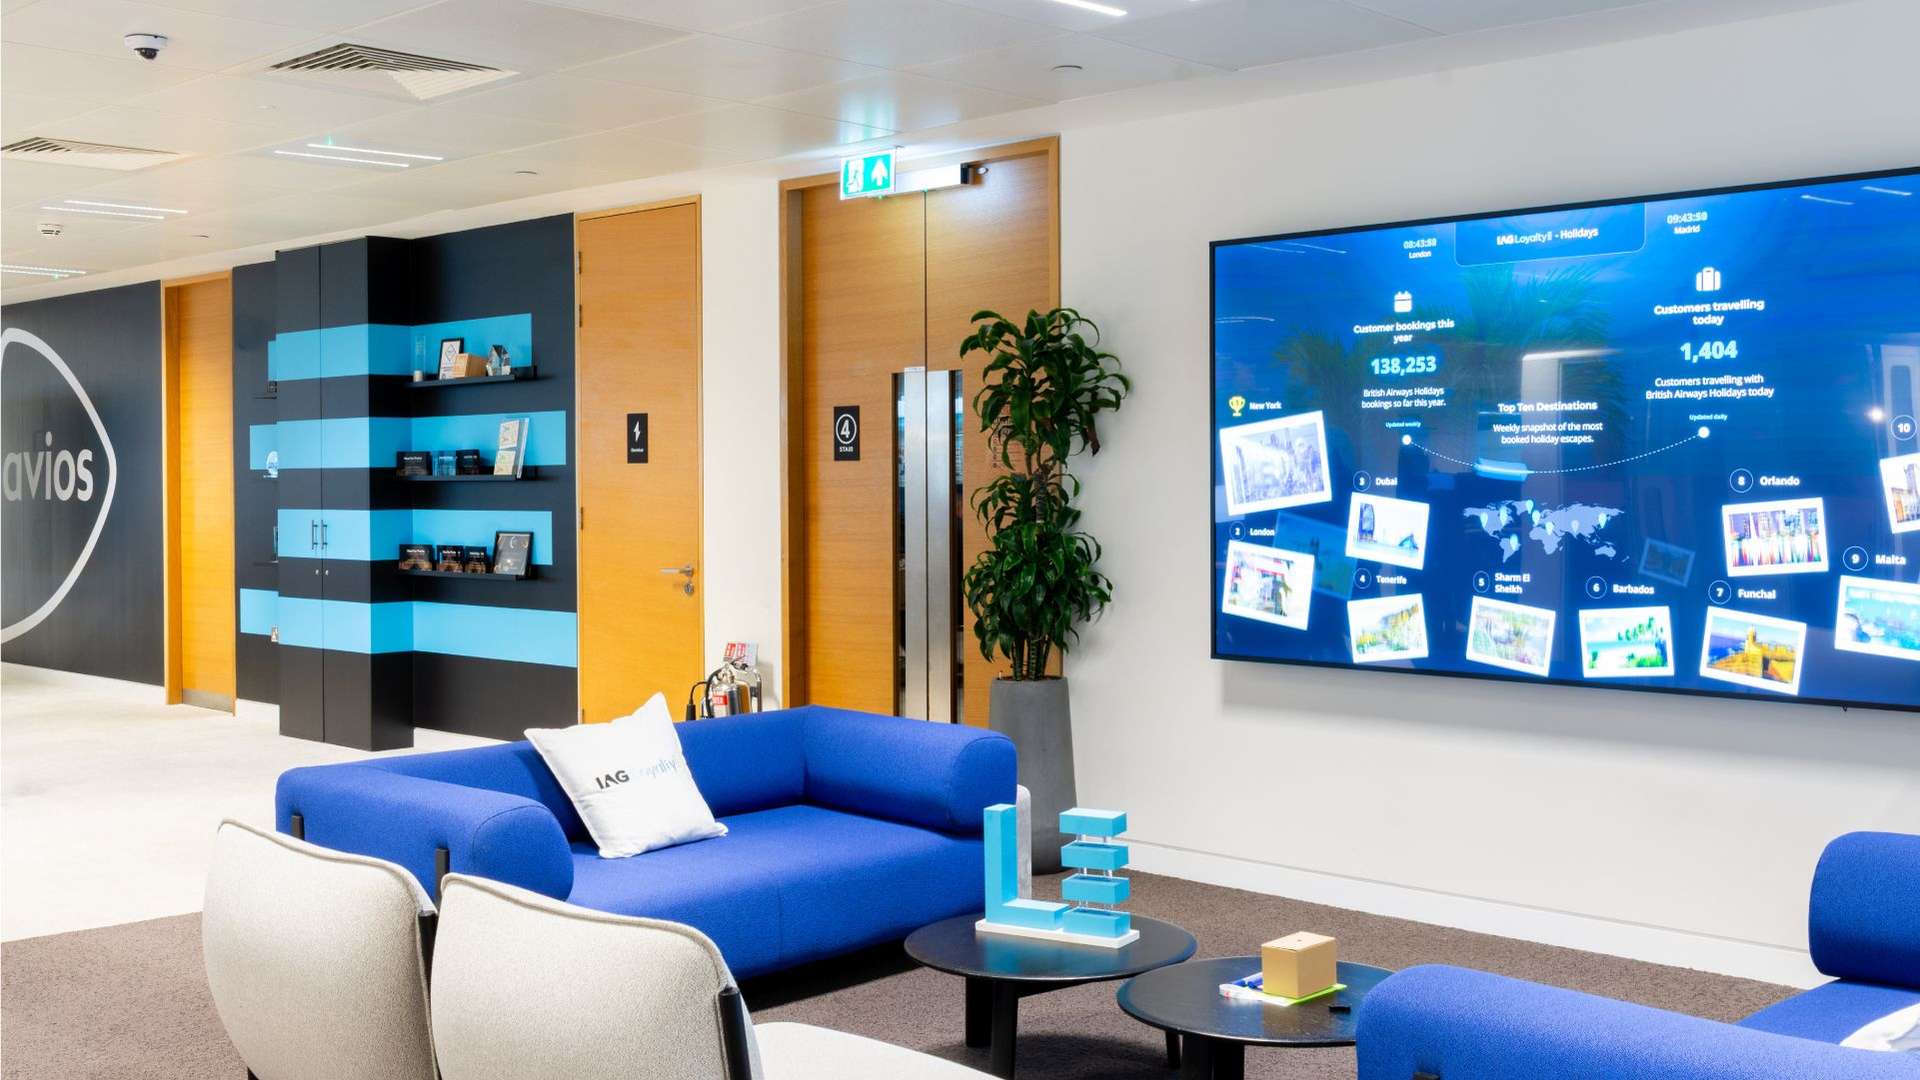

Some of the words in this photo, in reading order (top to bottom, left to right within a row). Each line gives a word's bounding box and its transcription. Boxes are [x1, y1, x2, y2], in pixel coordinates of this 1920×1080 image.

[1674, 225, 1701, 234] Madrid
[1497, 235, 1515, 245] IAG
[1560, 228, 1599, 239] Holidays
[1408, 251, 1432, 259] London
[1654, 303, 1711, 315] Customers
[1712, 299, 1765, 311] travelling
[1353, 324, 1395, 334] Customer
[1396, 321, 1437, 332] bookings
[1437, 318, 1455, 329] this
[1692, 314, 1724, 326] today
[1393, 334, 1413, 344] year
[1680, 340, 1738, 363] 1,404
[1371, 355, 1437, 376] 138,253
[1655, 377, 1700, 387] Customers
[1702, 374, 1743, 386] travelling
[1743, 373, 1764, 384] with
[1363, 389, 1385, 398] British
[1386, 388, 1413, 398] Airways
[1414, 386, 1445, 397] Holidays
[1645, 390, 1673, 400] British
[1674, 389, 1708, 400] Airways
[1709, 387, 1746, 399] Holidays
[1748, 386, 1774, 398] today
[1249, 402, 1265, 411] New
[1265, 400, 1282, 409] York
[1361, 400, 1392, 410] bookings
[1402, 399, 1413, 408] far
[1414, 398, 1427, 407] this
[1428, 400, 1447, 409] year.
[1497, 402, 1517, 414] Top
[1517, 401, 1535, 412] Ten
[1536, 399, 1598, 411] Destinations
[840, 419, 850, 439] 4
[1492, 424, 1520, 434] Weekly
[1521, 422, 1557, 434] snapshot
[1557, 421, 1567, 431] of
[1567, 421, 1581, 431] the
[1582, 422, 1603, 431] most
[1898, 423, 1911, 433] 10
[1501, 435, 1530, 444] booked
[1530, 434, 1559, 445] holiday
[1560, 435, 1594, 445] escapes.
[2, 431, 94, 501] avios
[1359, 477, 1365, 486] 3
[1375, 477, 1398, 486] Dubai
[1738, 476, 1745, 486] 8
[1759, 476, 1801, 486] Orlando
[1235, 527, 1240, 535] 2
[1249, 528, 1276, 536] London
[1851, 554, 1859, 564] 9
[1875, 555, 1906, 566] Malta
[1360, 574, 1366, 583] 4
[1375, 575, 1408, 585] Tenerife
[1479, 578, 1485, 587] 5
[1495, 572, 1521, 582] Sharm
[1522, 573, 1531, 583] El
[1495, 584, 1523, 595] Sheikh
[1593, 583, 1600, 593] 6
[1612, 583, 1655, 595] Barbados
[1716, 587, 1724, 598] 7
[1738, 589, 1776, 600] Funchal
[595, 769, 630, 789] IAG
